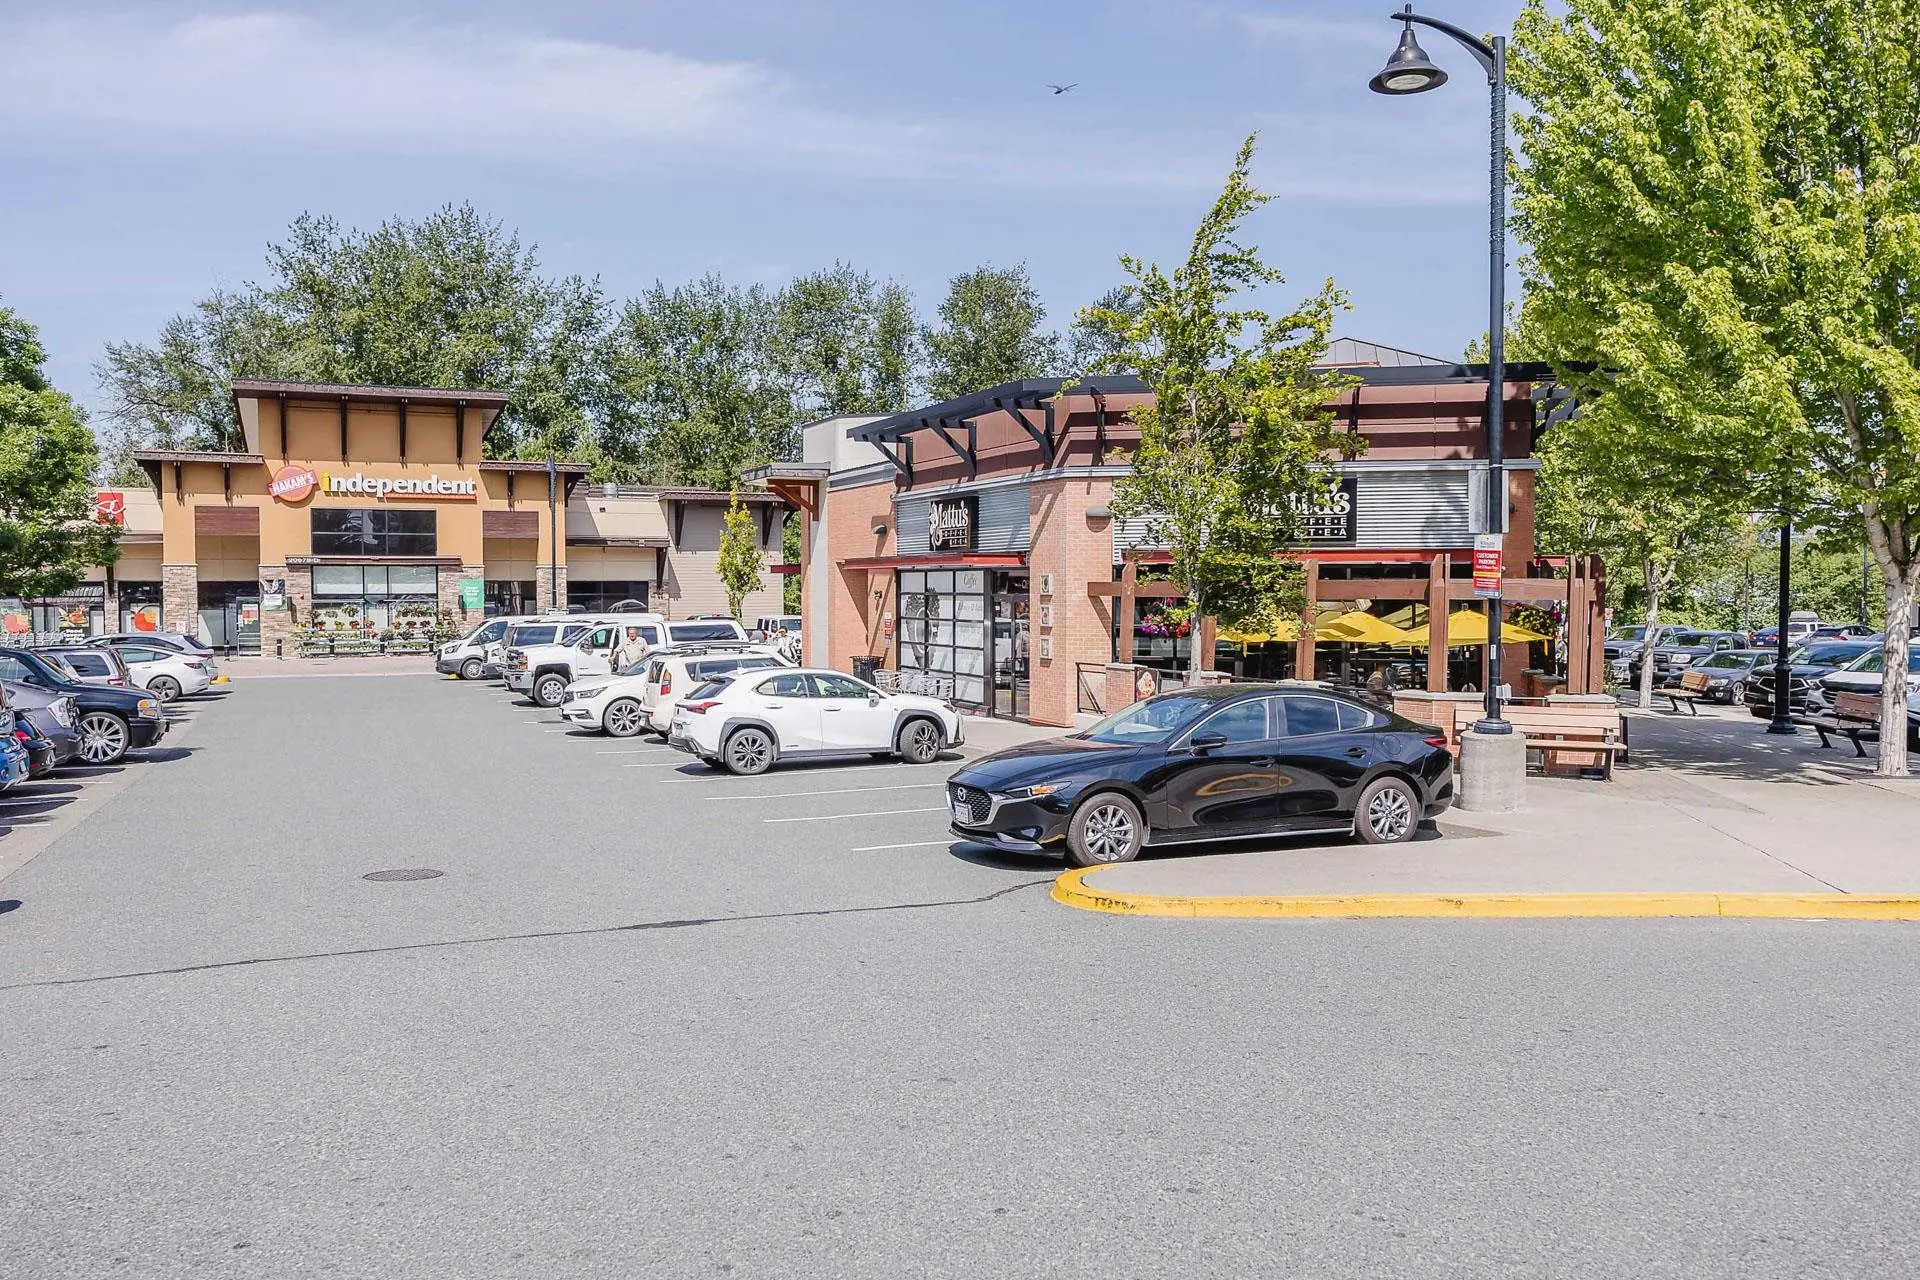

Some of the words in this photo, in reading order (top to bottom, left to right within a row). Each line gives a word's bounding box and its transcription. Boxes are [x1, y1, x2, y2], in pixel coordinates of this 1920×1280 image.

[271, 471, 314, 493] HAKAM'S
[321, 472, 476, 498] independent
[930, 500, 969, 545] Mattu's
